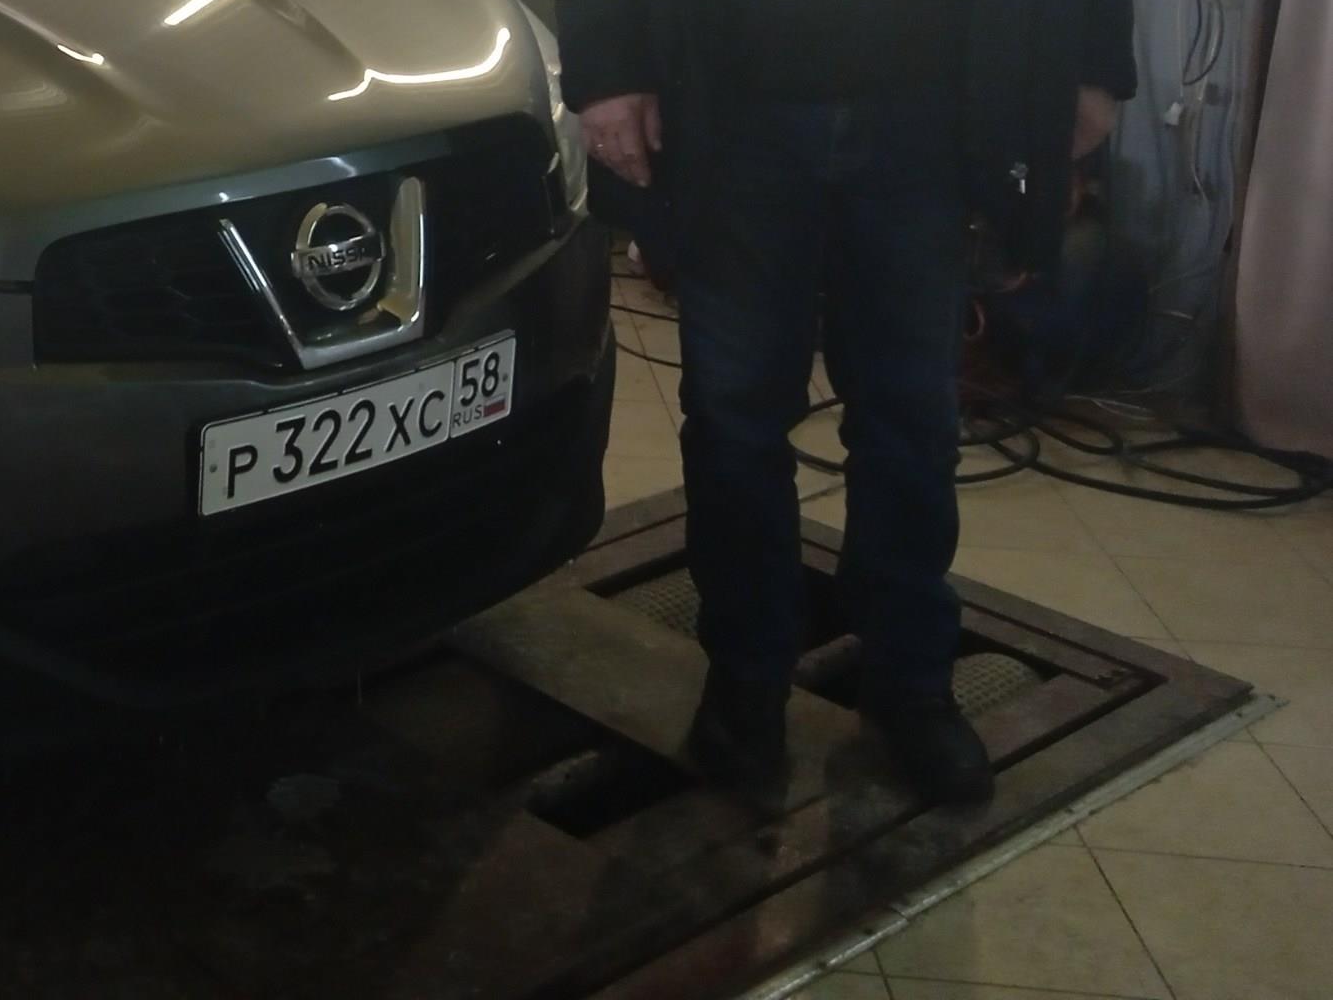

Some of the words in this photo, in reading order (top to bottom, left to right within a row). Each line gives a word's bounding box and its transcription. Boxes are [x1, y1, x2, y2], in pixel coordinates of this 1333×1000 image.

[307, 244, 371, 269] NISS
[460, 352, 500, 407] 58
[452, 407, 483, 429] RUS
